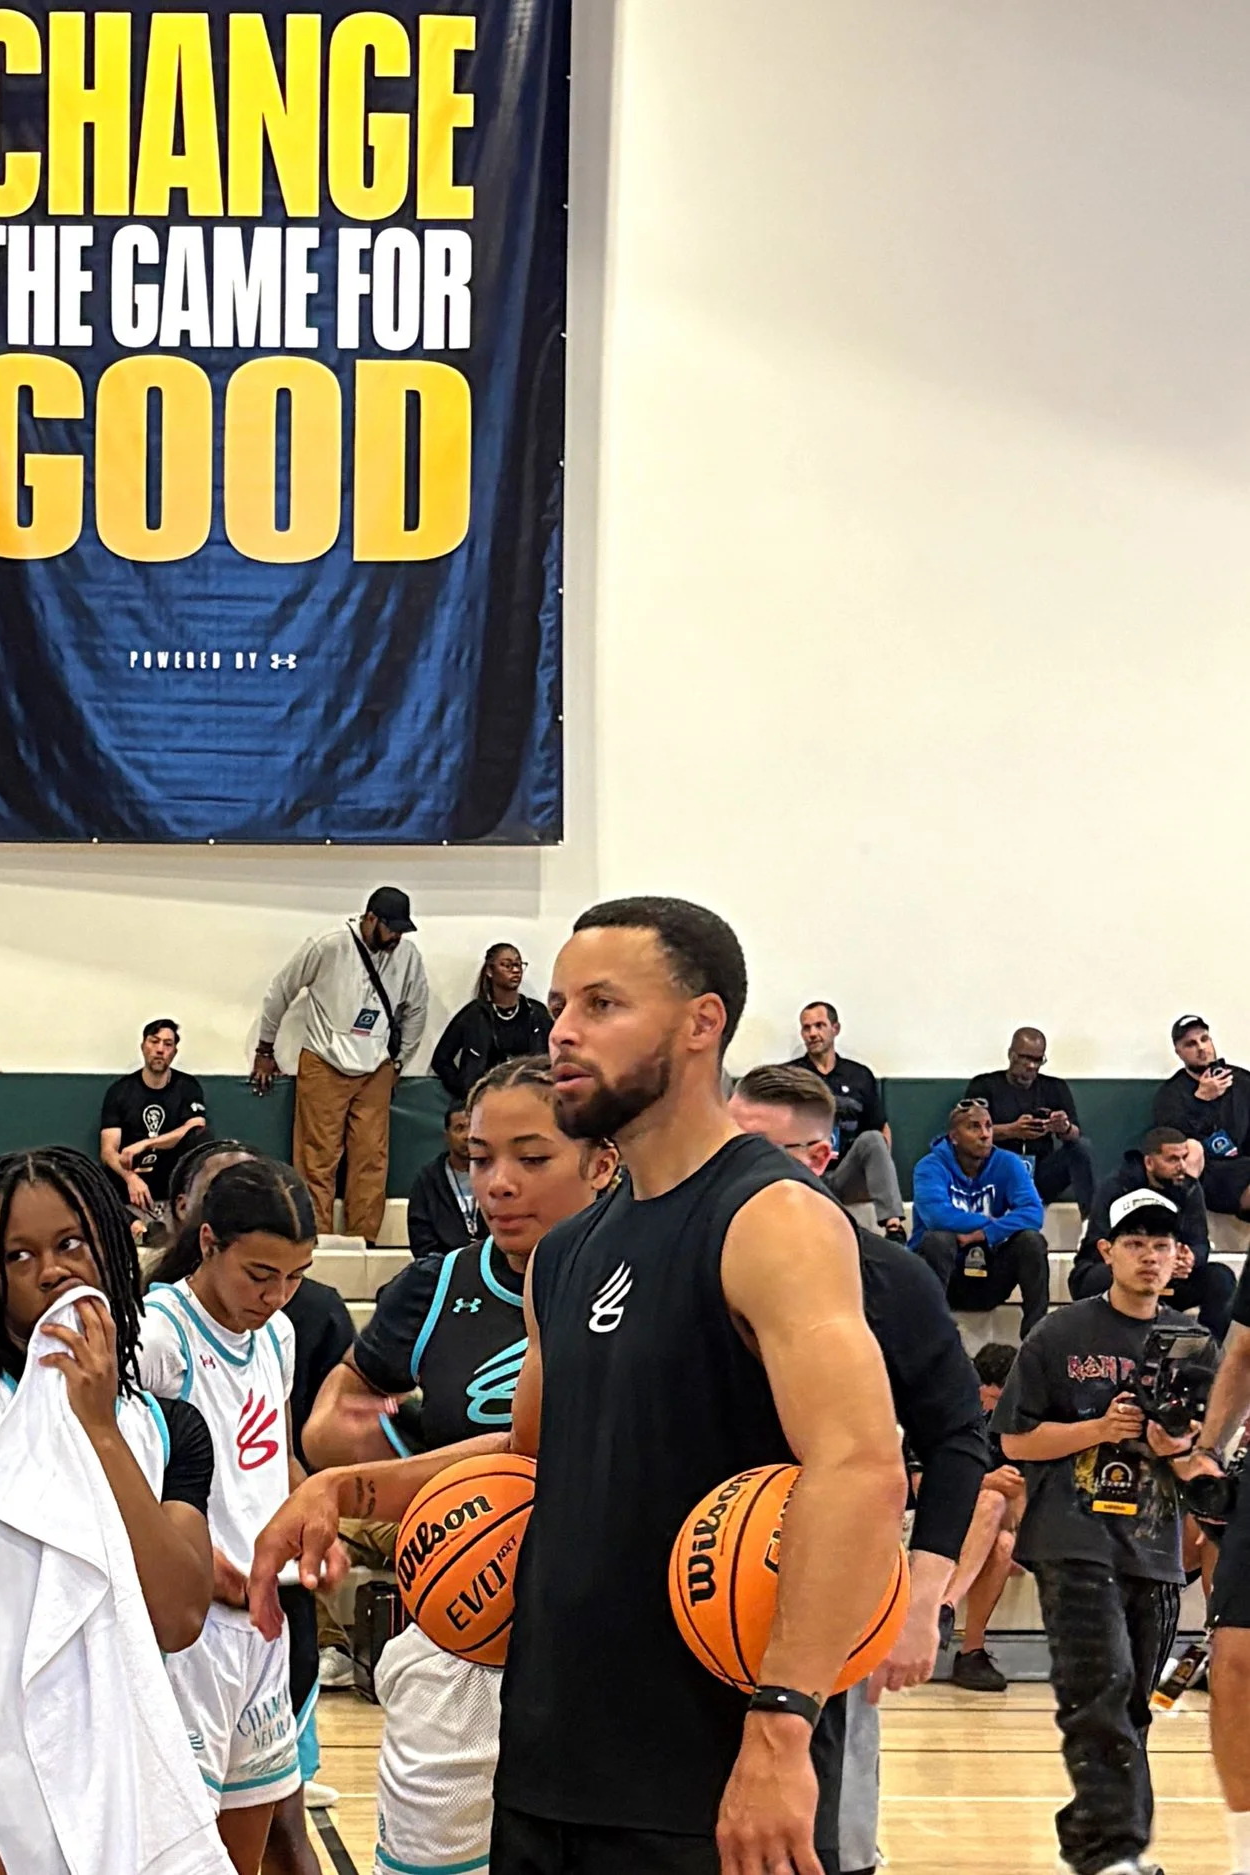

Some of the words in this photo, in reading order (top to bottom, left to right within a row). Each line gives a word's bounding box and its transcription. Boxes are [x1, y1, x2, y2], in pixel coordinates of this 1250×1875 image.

[110, 225, 320, 350] GAME
[337, 226, 473, 351] FOR
[129, 650, 221, 670] POWERED
[235, 651, 258, 670] BY
[397, 1494, 494, 1593] Wilson
[687, 1469, 764, 1608] Wilson
